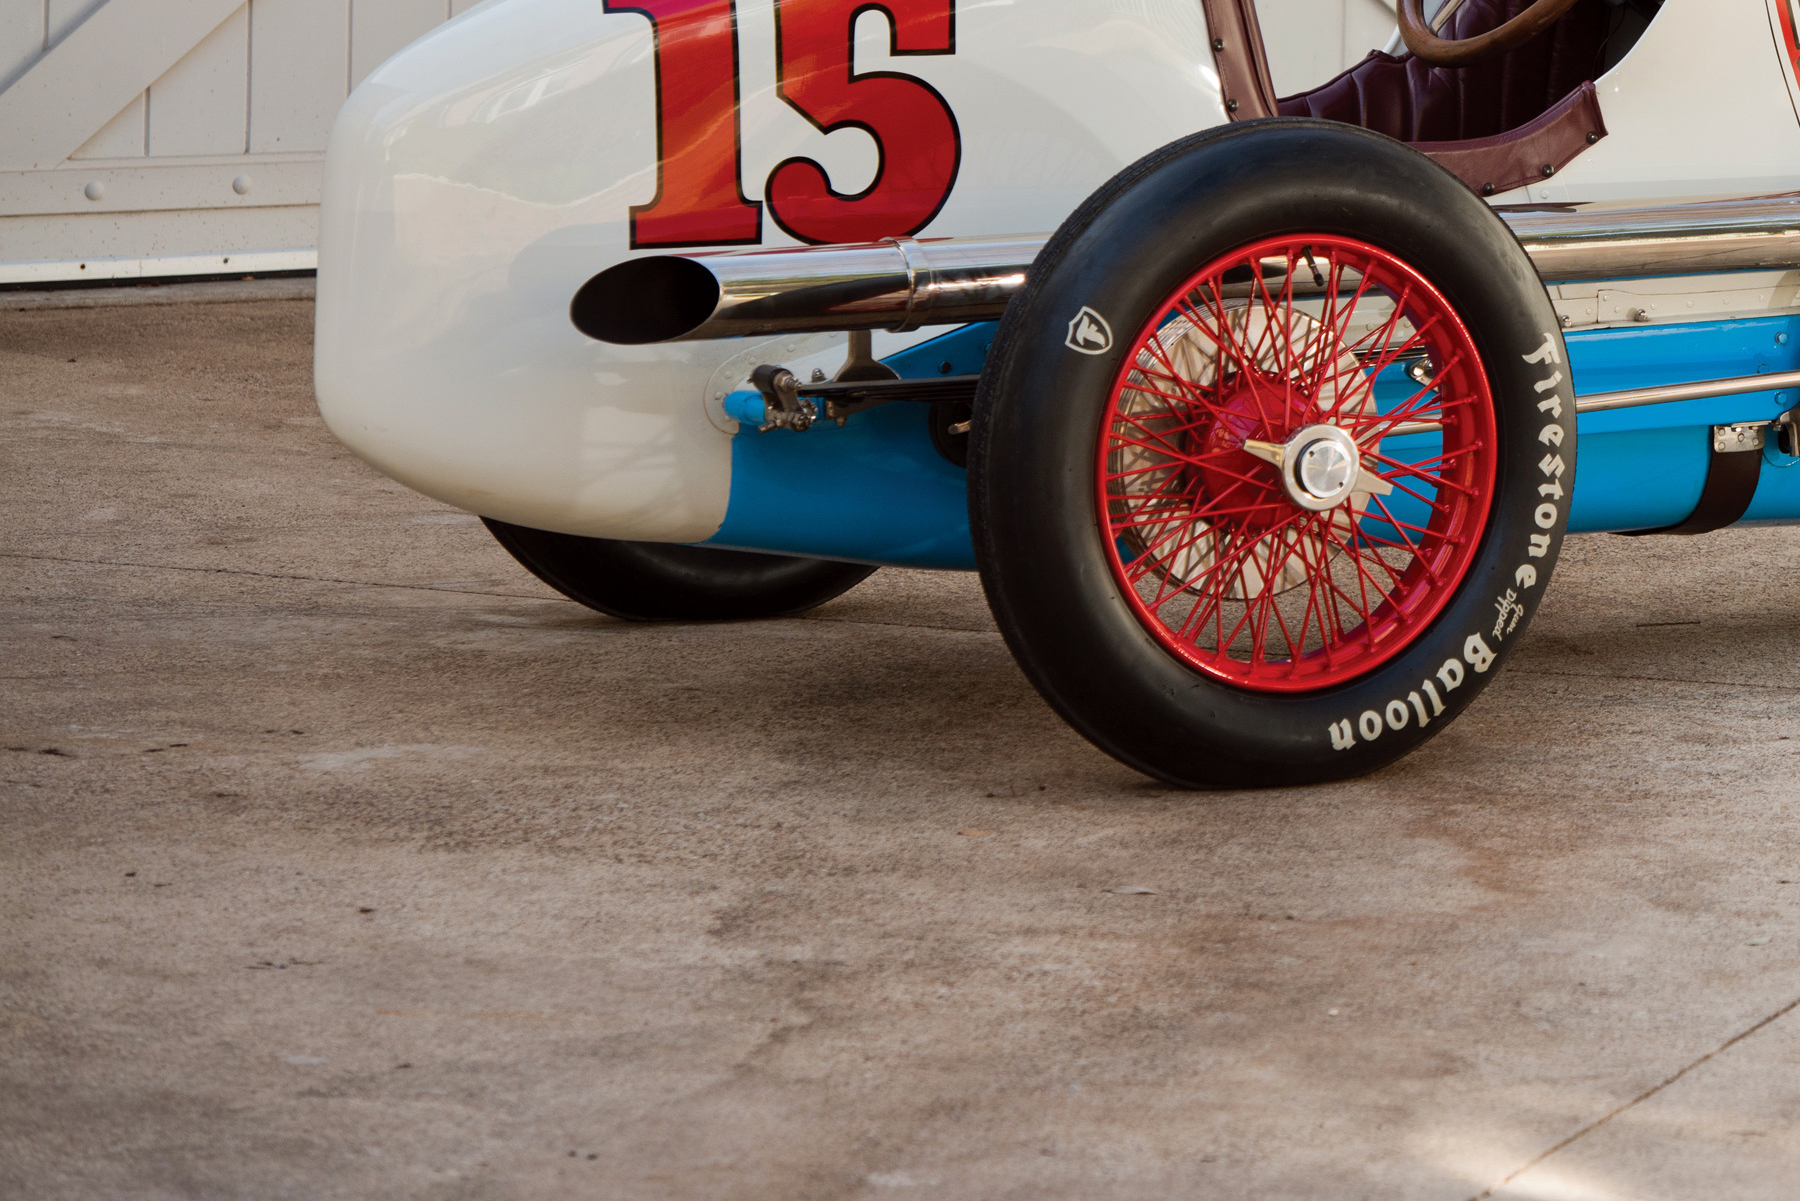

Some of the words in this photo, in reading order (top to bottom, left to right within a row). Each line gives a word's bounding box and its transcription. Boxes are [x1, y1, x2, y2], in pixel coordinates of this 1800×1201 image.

[1515, 331, 1567, 590] Firestone
[1492, 587, 1518, 642] Dipped
[1327, 631, 1498, 751] Balloon
